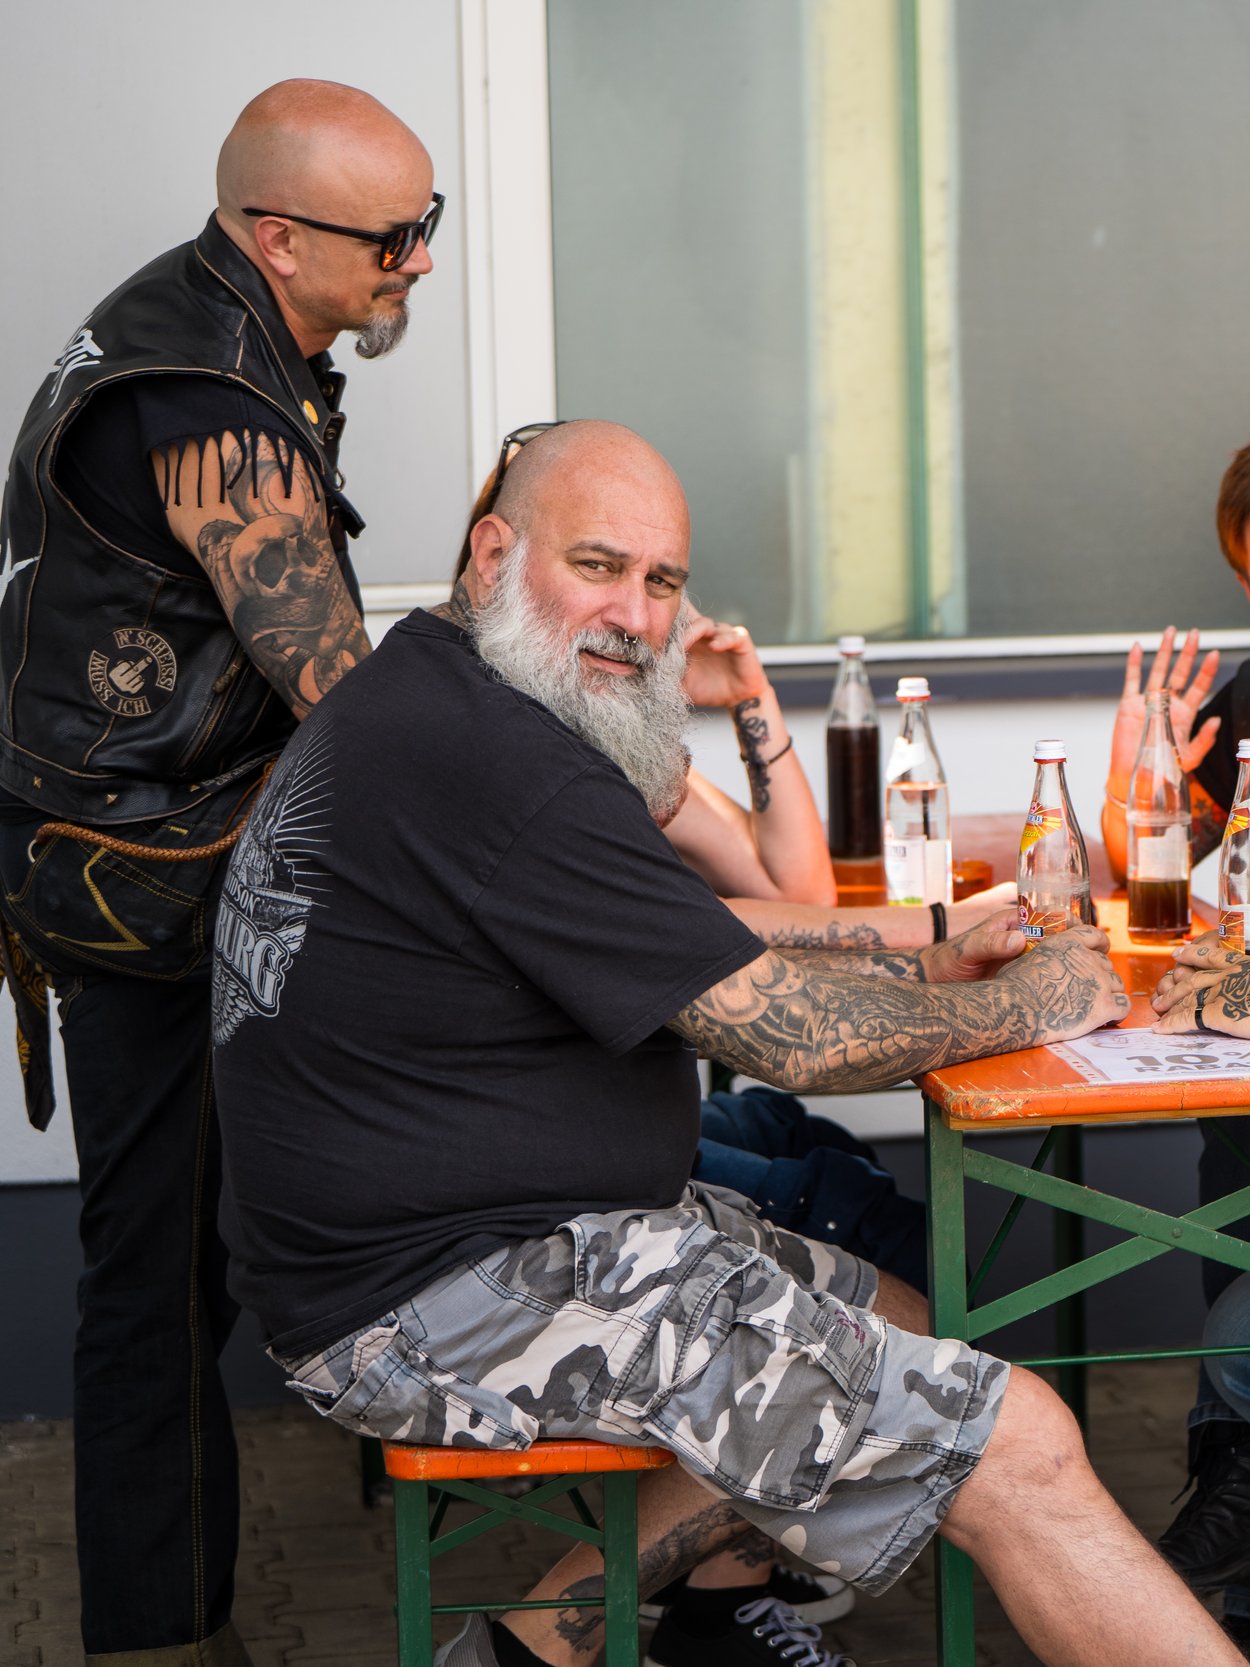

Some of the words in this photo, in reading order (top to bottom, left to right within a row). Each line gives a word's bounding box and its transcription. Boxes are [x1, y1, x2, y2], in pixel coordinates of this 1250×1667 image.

[91, 656, 114, 702] MUSS
[117, 697, 145, 714] ICH
[136, 631, 175, 687] SCHEISS
